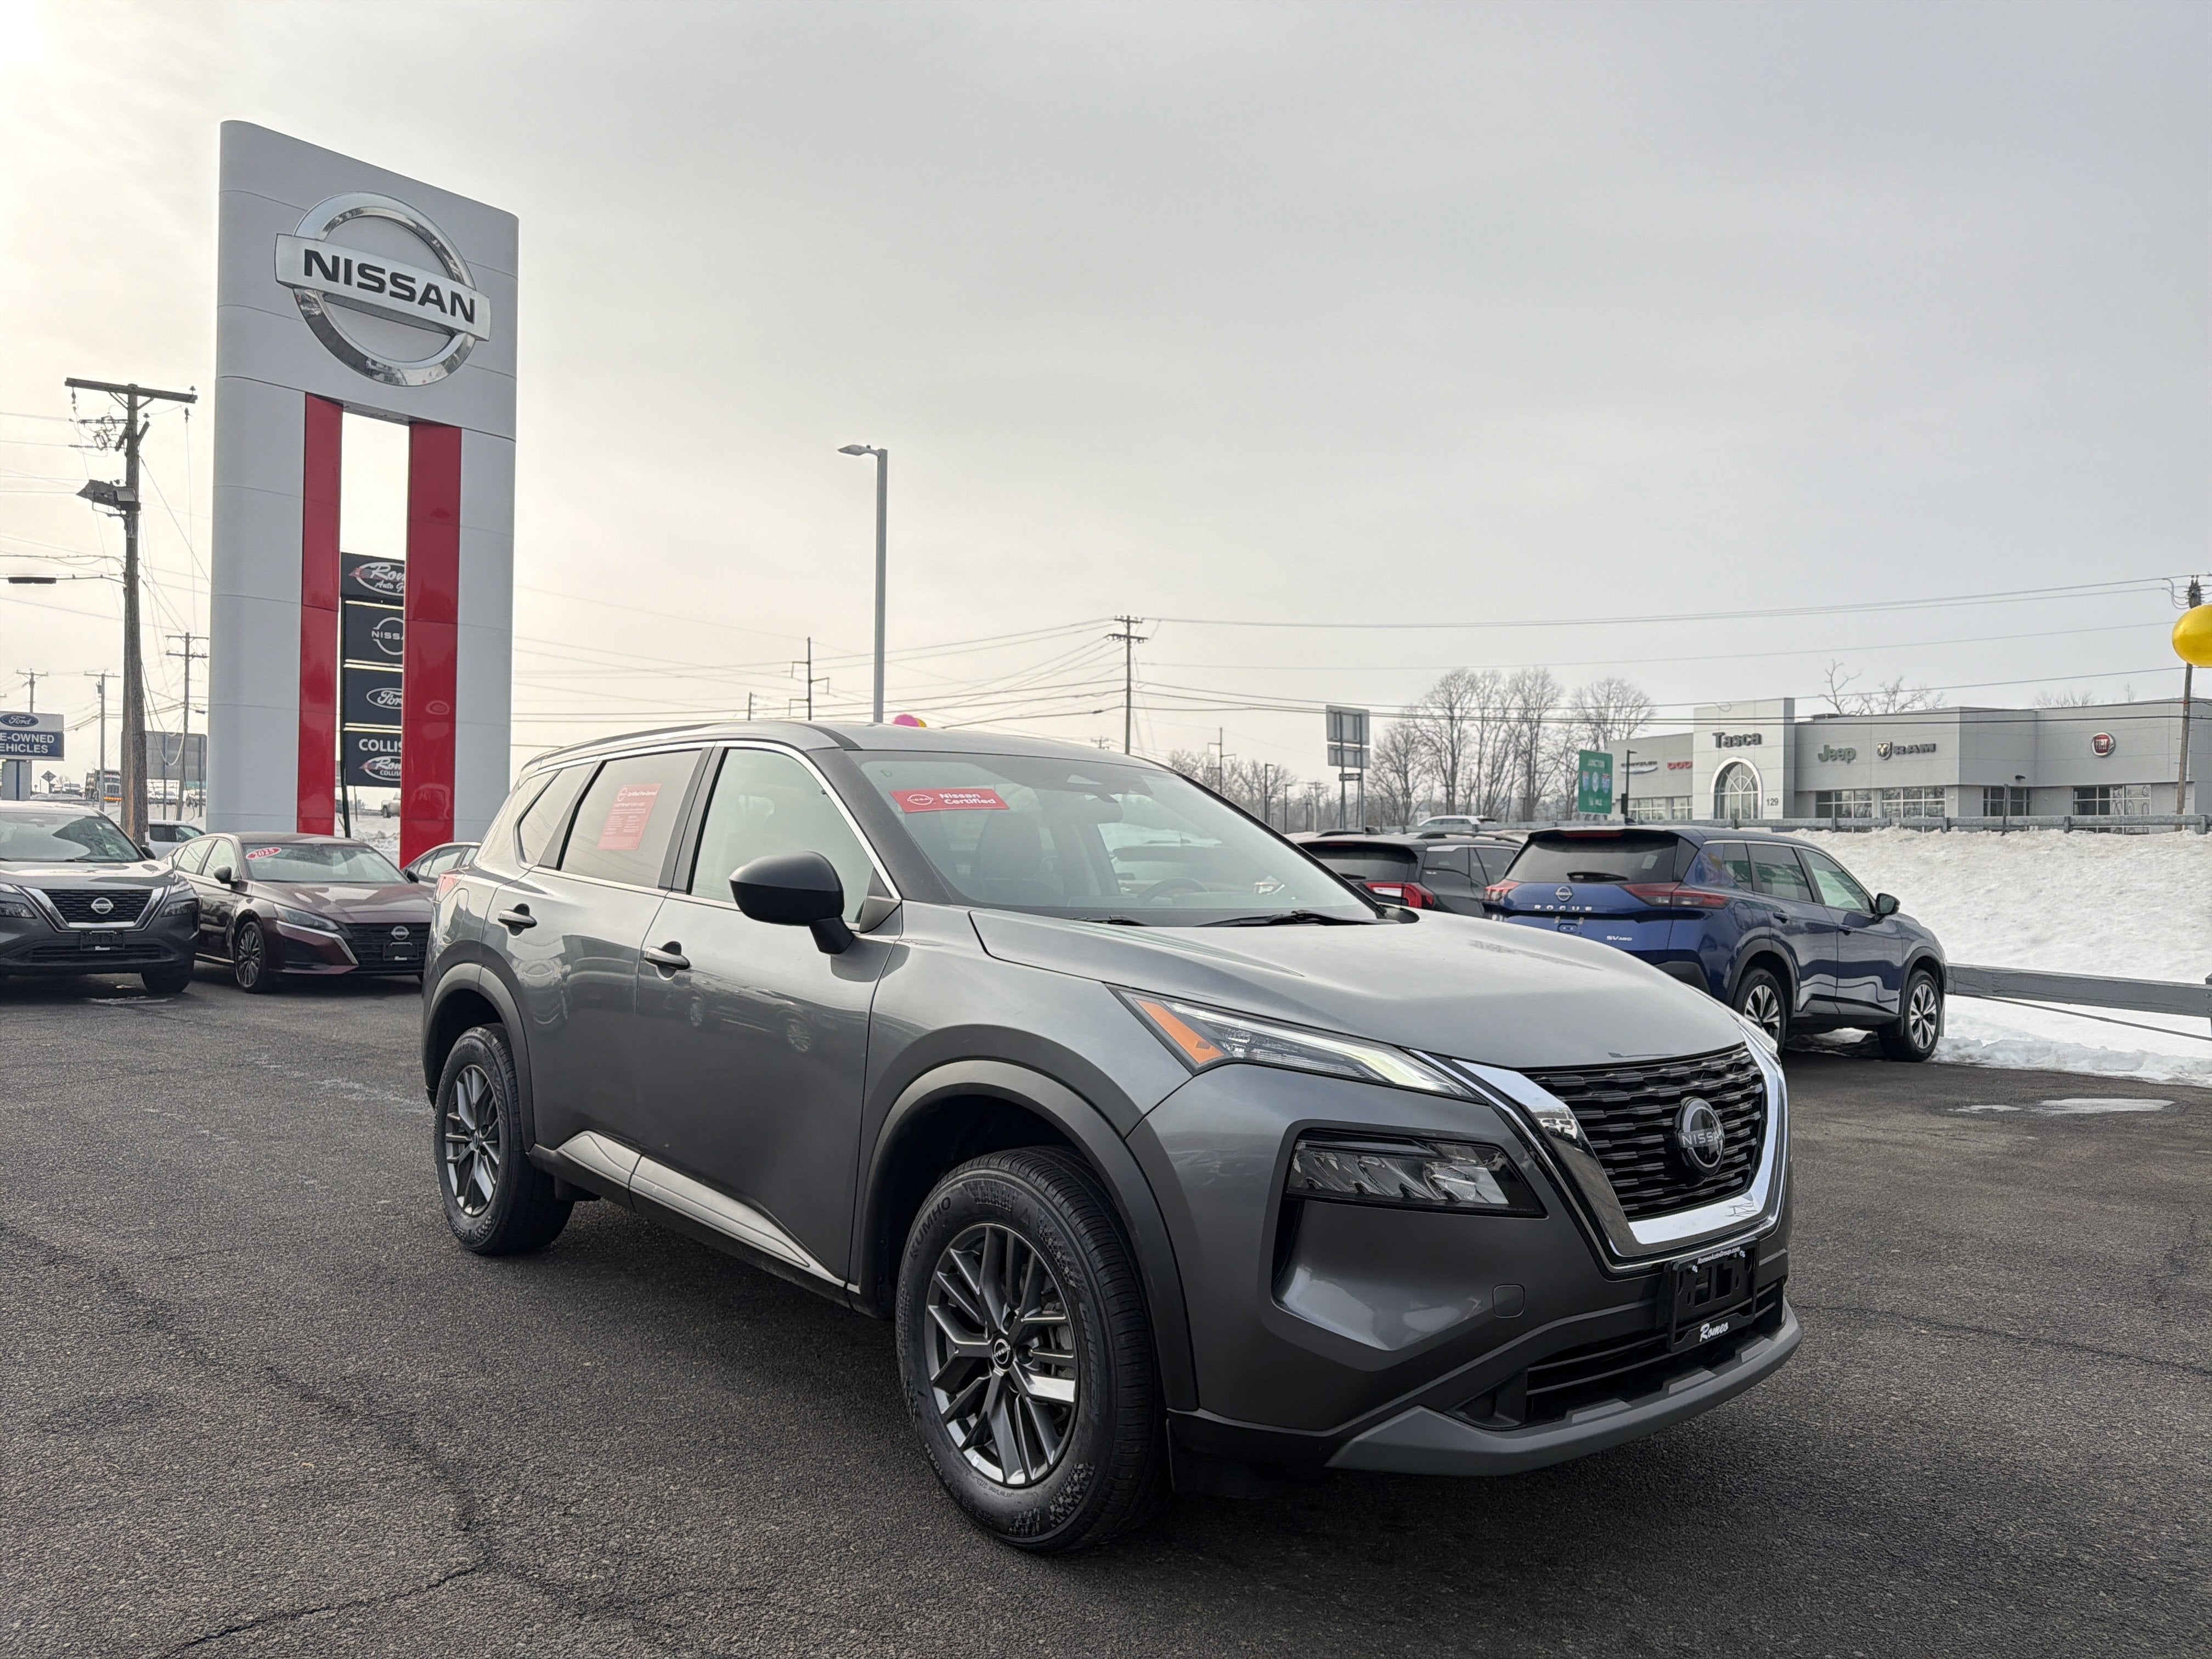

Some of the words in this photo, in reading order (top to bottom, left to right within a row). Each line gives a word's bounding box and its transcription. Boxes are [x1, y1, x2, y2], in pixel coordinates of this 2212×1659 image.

[303, 249, 475, 324] NISSAN
[375, 580, 394, 589] Auto
[9, 715, 31, 725] Ford
[1712, 732, 1762, 748] Tasca
[1818, 744, 1857, 764] Jeep
[1893, 743, 1936, 755] RAM
[1681, 1129, 1724, 1146] NISSAN
[910, 1197, 951, 1261] KUMHO
[1700, 1322, 1729, 1342] Romeo
